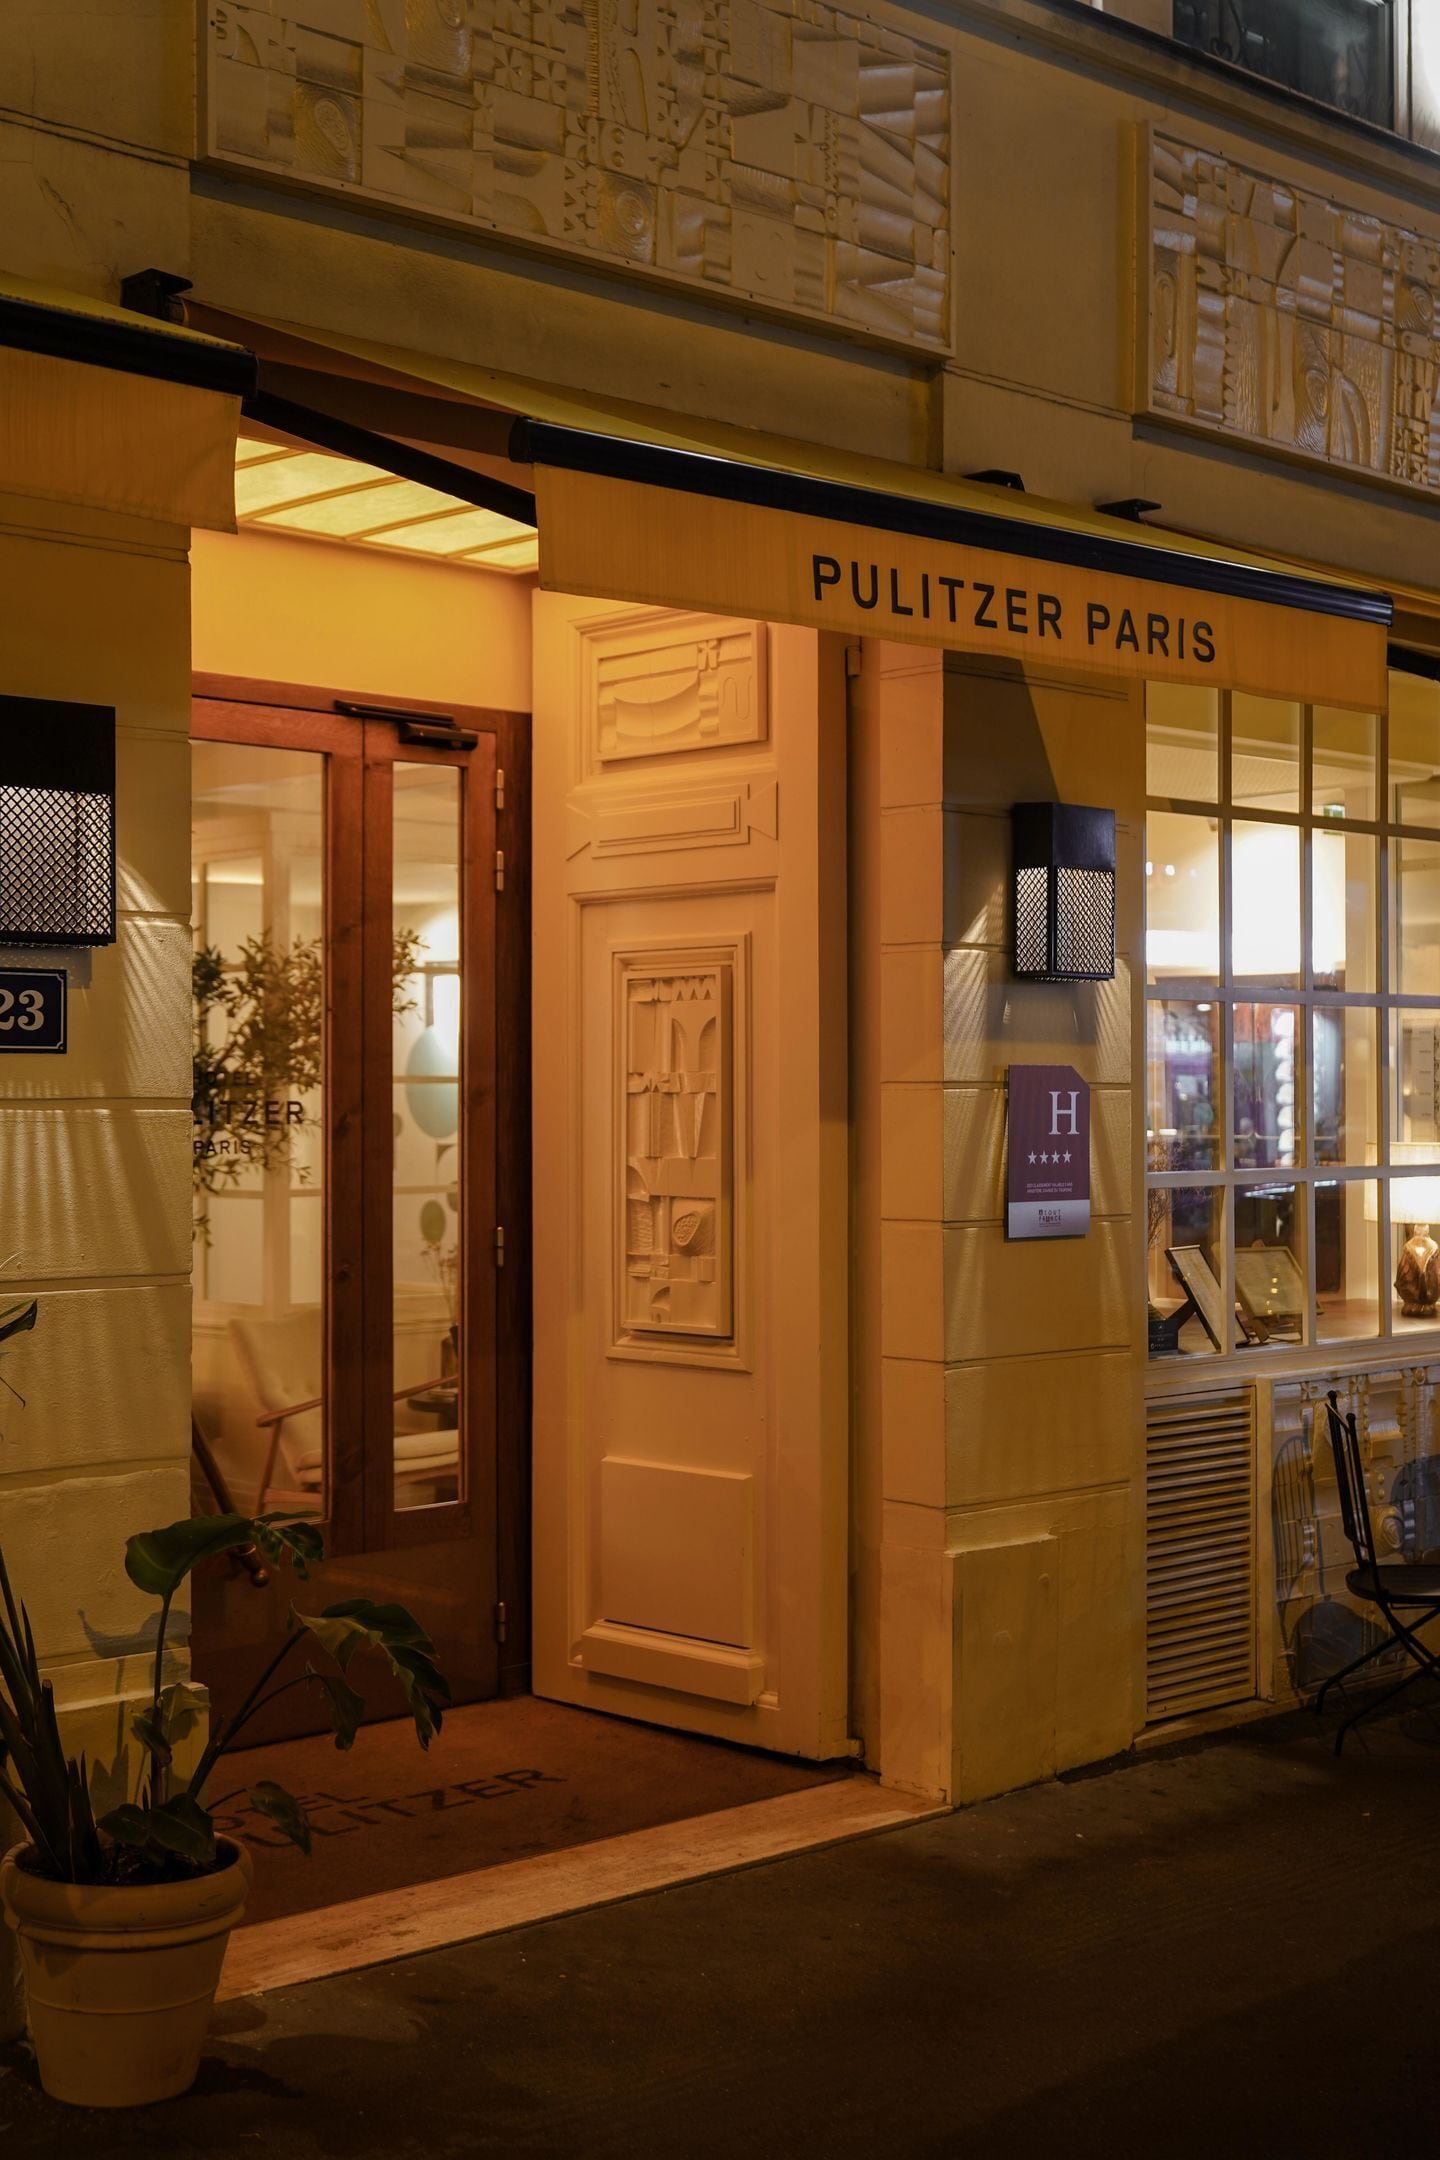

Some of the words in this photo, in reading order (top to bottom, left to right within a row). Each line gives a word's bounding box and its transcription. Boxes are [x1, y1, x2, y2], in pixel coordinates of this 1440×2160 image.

[812, 554, 1062, 640] PULITZER
[1087, 603, 1216, 663] PARIS
[1048, 1091, 1081, 1135] H
[193, 1140, 252, 1155] PARIS
